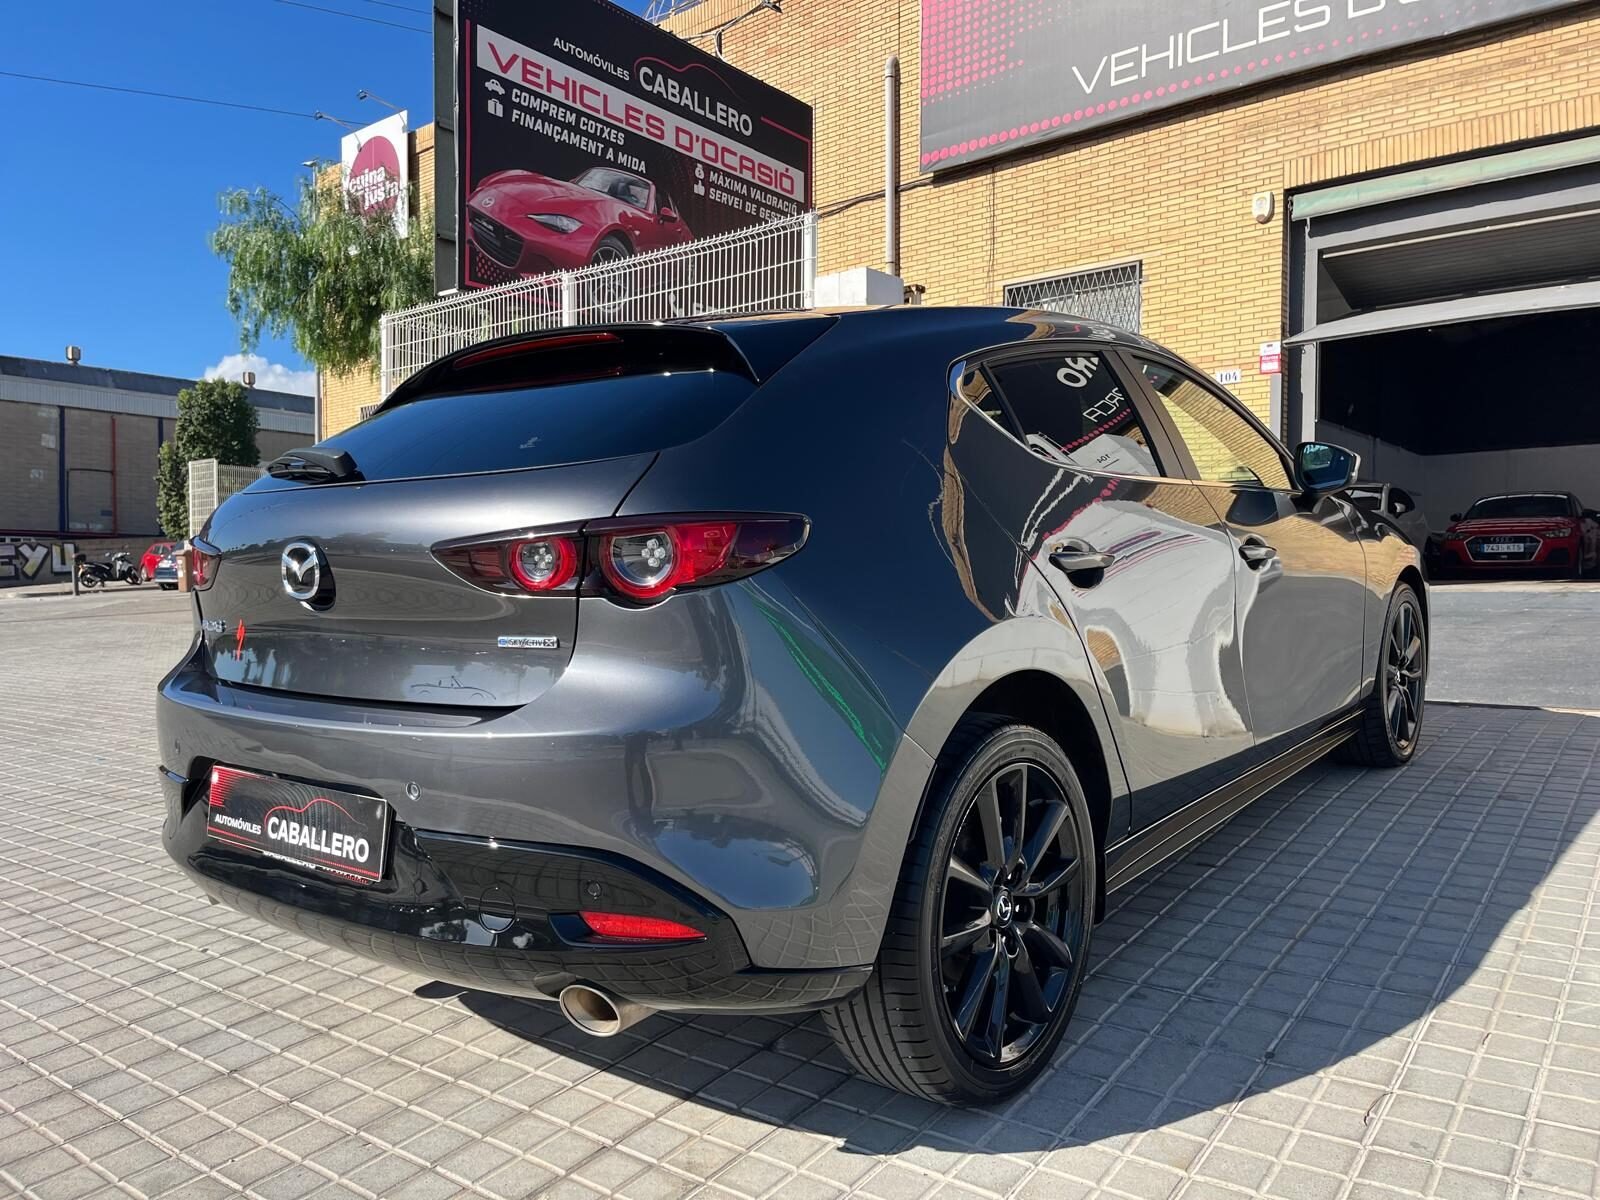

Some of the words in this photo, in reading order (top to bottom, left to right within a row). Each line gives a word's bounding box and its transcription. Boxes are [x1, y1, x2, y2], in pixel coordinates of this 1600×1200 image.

[1072, 0, 1330, 95] VEHICLES
[553, 37, 630, 82] AUTOMÓVILES
[639, 66, 753, 137] CABALLERO
[487, 42, 666, 141] VEHICLES
[675, 128, 795, 196] D'OCASIÓ
[511, 88, 576, 126] COMPREM
[579, 116, 626, 146] COTXES
[511, 109, 605, 157] FINANÇAMENT
[606, 147, 615, 161] A
[617, 149, 647, 174] MIDA
[709, 171, 748, 197] MÀXIMA
[750, 186, 798, 216] VALORACIÓ
[709, 188, 743, 211] SERVEI
[745, 201, 758, 216] DE
[1219, 371, 1238, 383] 104
[214, 814, 262, 835] AUTOMÓVILES
[267, 816, 370, 863] CABALLERO
